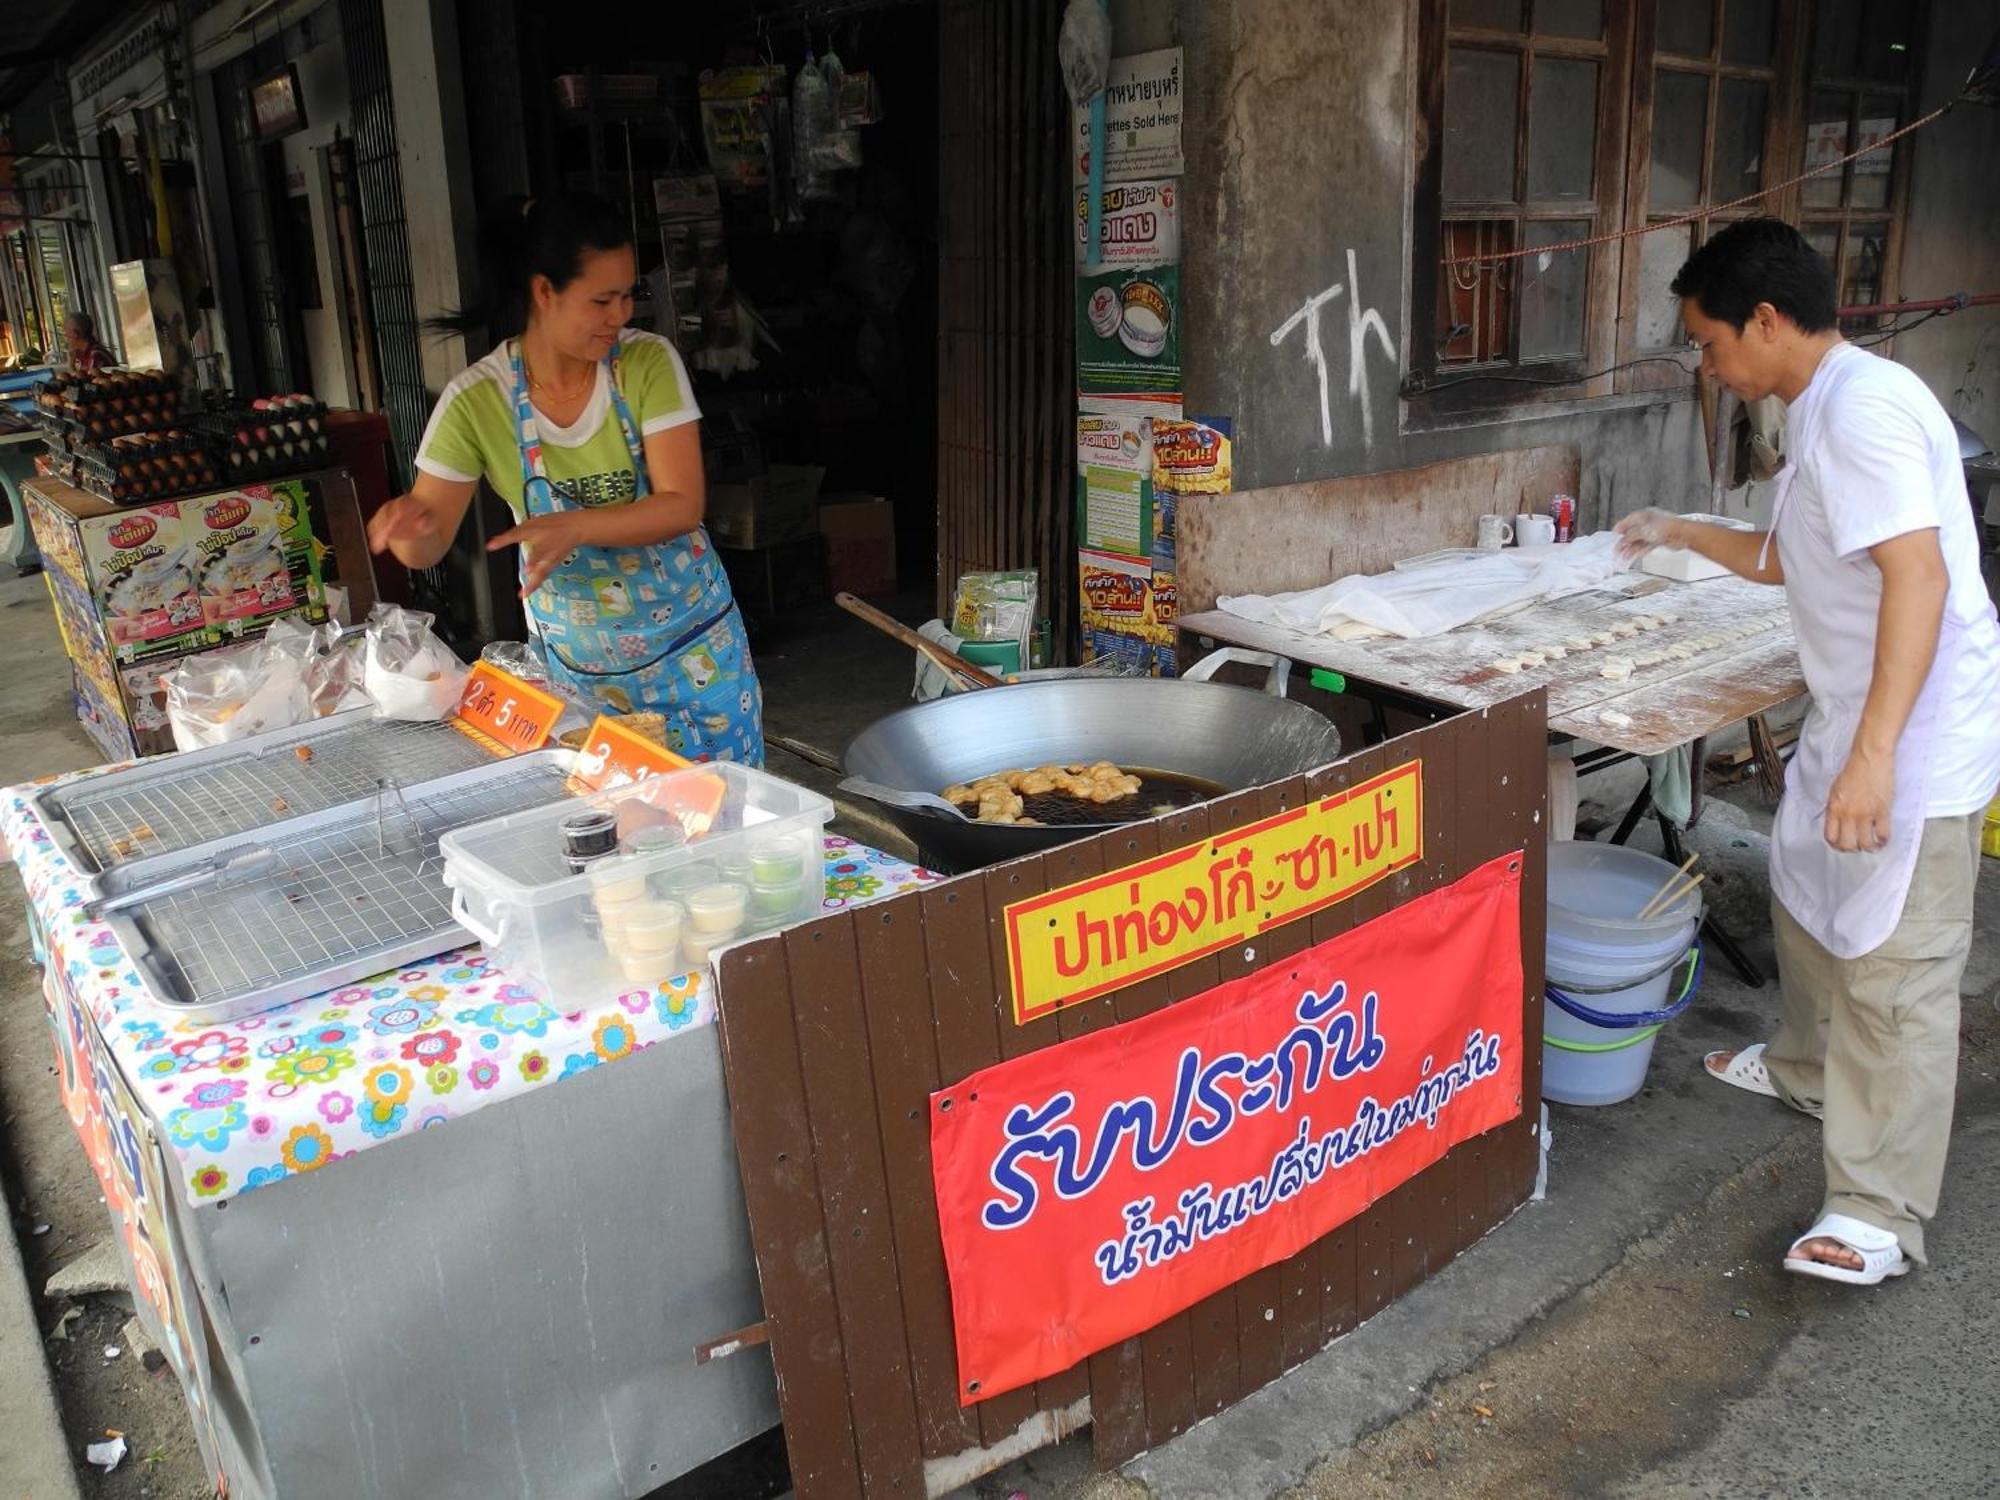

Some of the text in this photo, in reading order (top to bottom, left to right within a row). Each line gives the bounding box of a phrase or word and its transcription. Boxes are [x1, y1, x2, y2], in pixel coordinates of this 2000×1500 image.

[1081, 113, 1179, 136] Ciettes Sold Here
[1271, 249, 1397, 449] Th
[465, 680, 486, 708] 2
[495, 697, 518, 728] 5
[982, 981, 1384, 1229] รับประกัน
[1098, 1029, 1500, 1284] น้ำมันเปลี่ยนใหม่ทุกวัน
